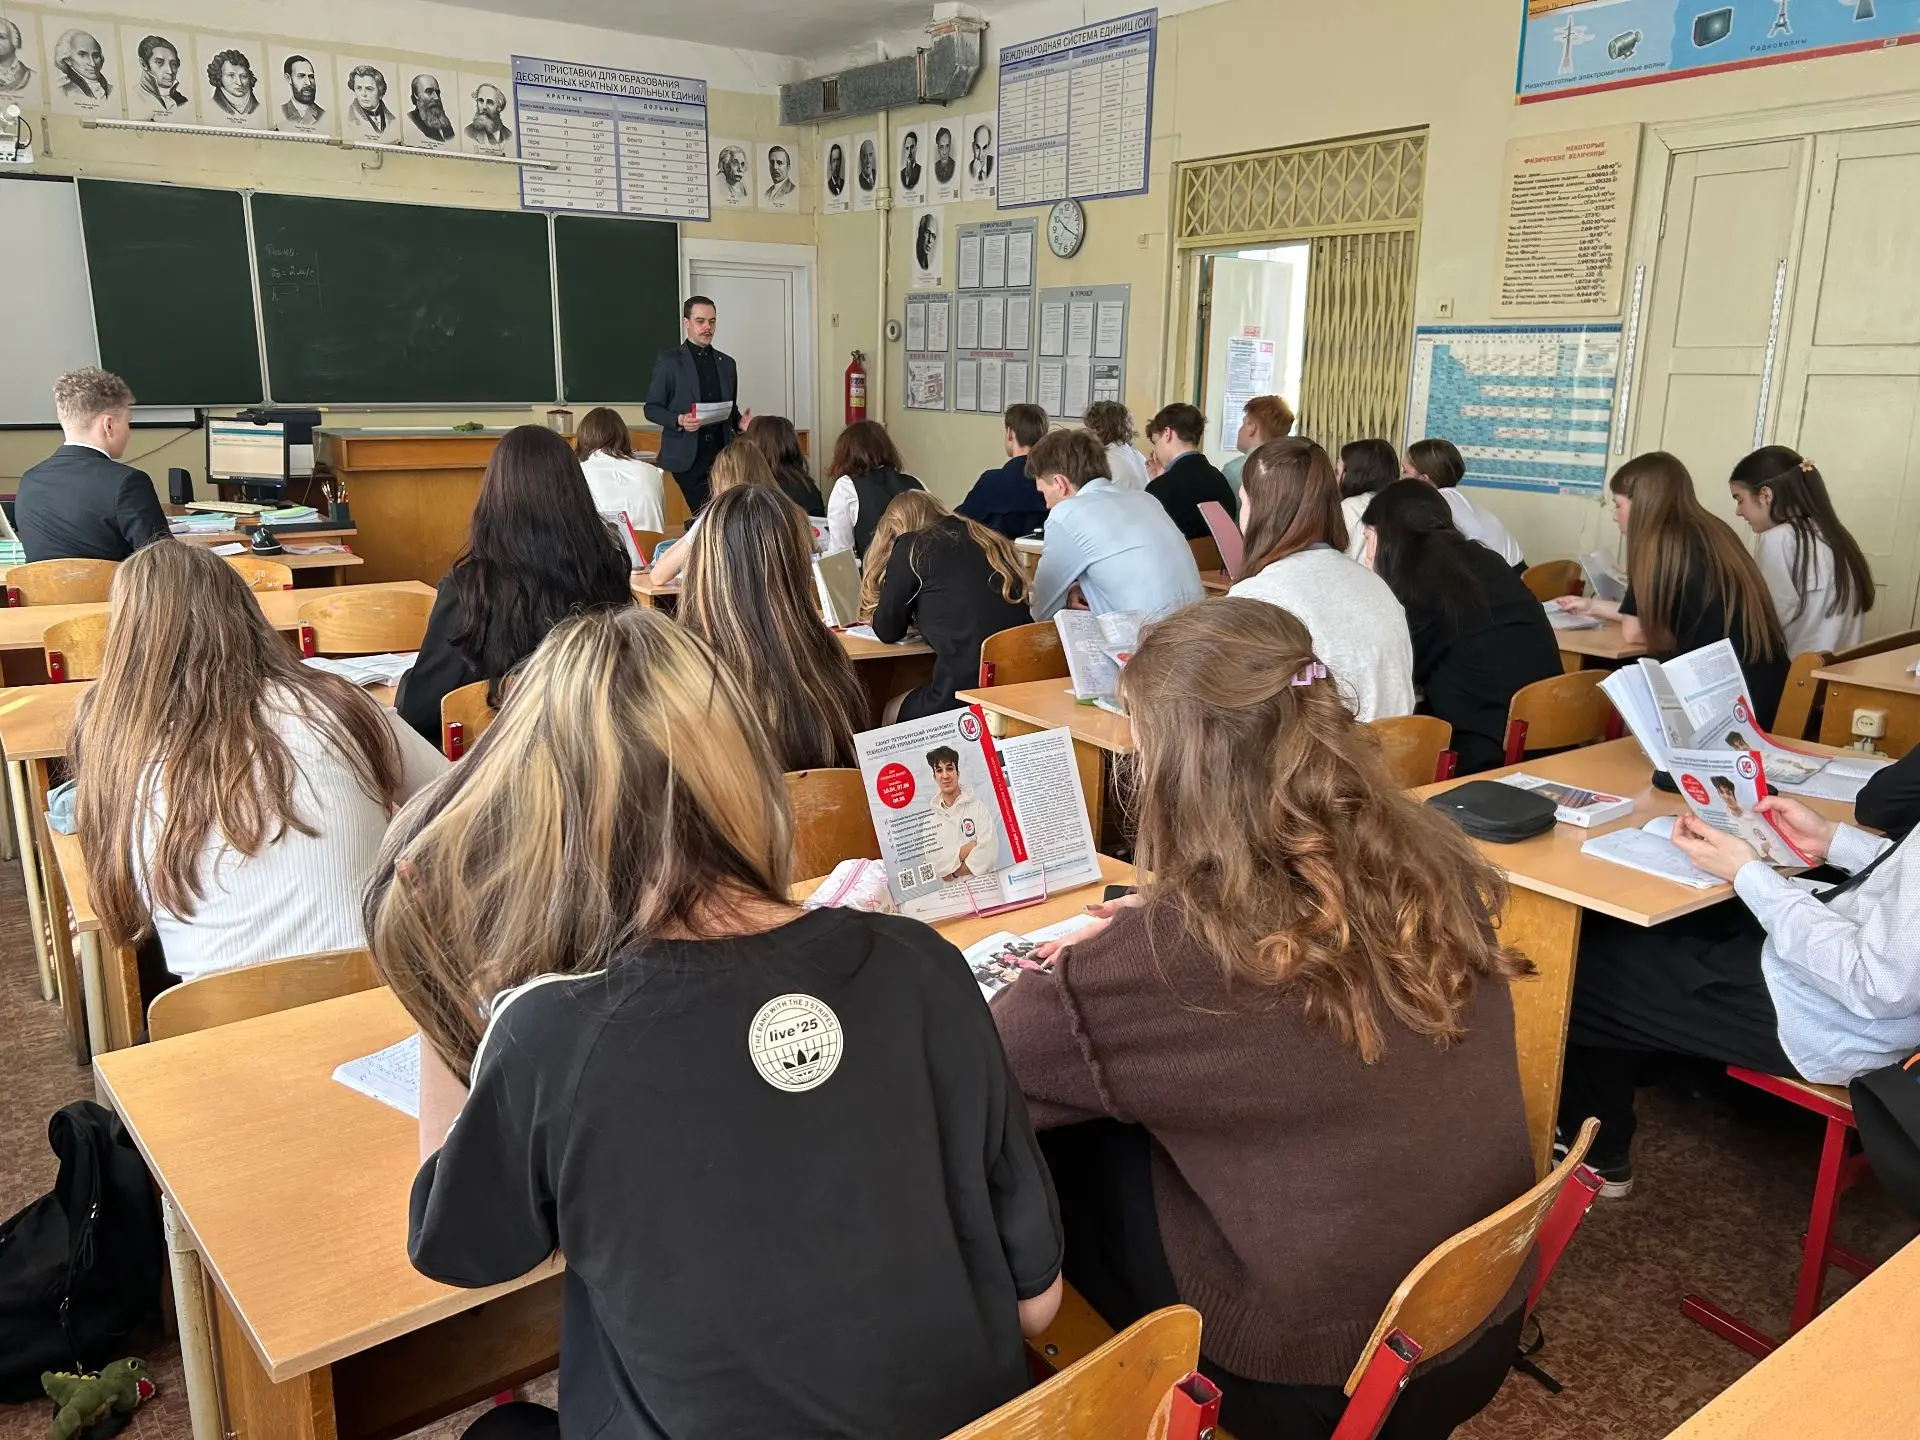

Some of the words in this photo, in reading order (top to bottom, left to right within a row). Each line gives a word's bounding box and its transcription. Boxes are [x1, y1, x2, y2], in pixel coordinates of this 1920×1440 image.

[1000, 38, 1062, 63] МЕЖДУНАРОДНАЯ
[1063, 30, 1098, 47] СИСТЕМА
[1100, 21, 1133, 38] ЕДИНИЦ
[1134, 16, 1152, 32] (СИ)
[1750, 38, 1808, 52] Радиоволны
[544, 64, 596, 79] ПРИСТАВКИ
[598, 71, 616, 81] ДЛЯ
[618, 74, 680, 89] ОБРАЗОВАНИЯ
[1578, 64, 1642, 81] электромагнитные
[516, 72, 576, 87] ДЕСЯТИЧНЫХ
[578, 80, 618, 92] КРАТНЫХ
[620, 85, 627, 94] И
[628, 86, 670, 99] ДОЛЬНЫХ
[672, 91, 706, 105] ЕДИНИЦ
[546, 93, 582, 102] КРАТНЫЕ
[644, 104, 680, 113] ДОЛЬНЫЕ
[1566, 142, 1605, 152] НЕКОТОРЫЕ
[1064, 204, 1070, 212] 12
[1054, 216, 1060, 224] 10
[1052, 226, 1058, 234] 9
[1054, 236, 1058, 244] 8
[756, 1012, 770, 1032] BAND
[769, 1002, 788, 1014] WITH
[810, 1003, 834, 1028] STRIPES
